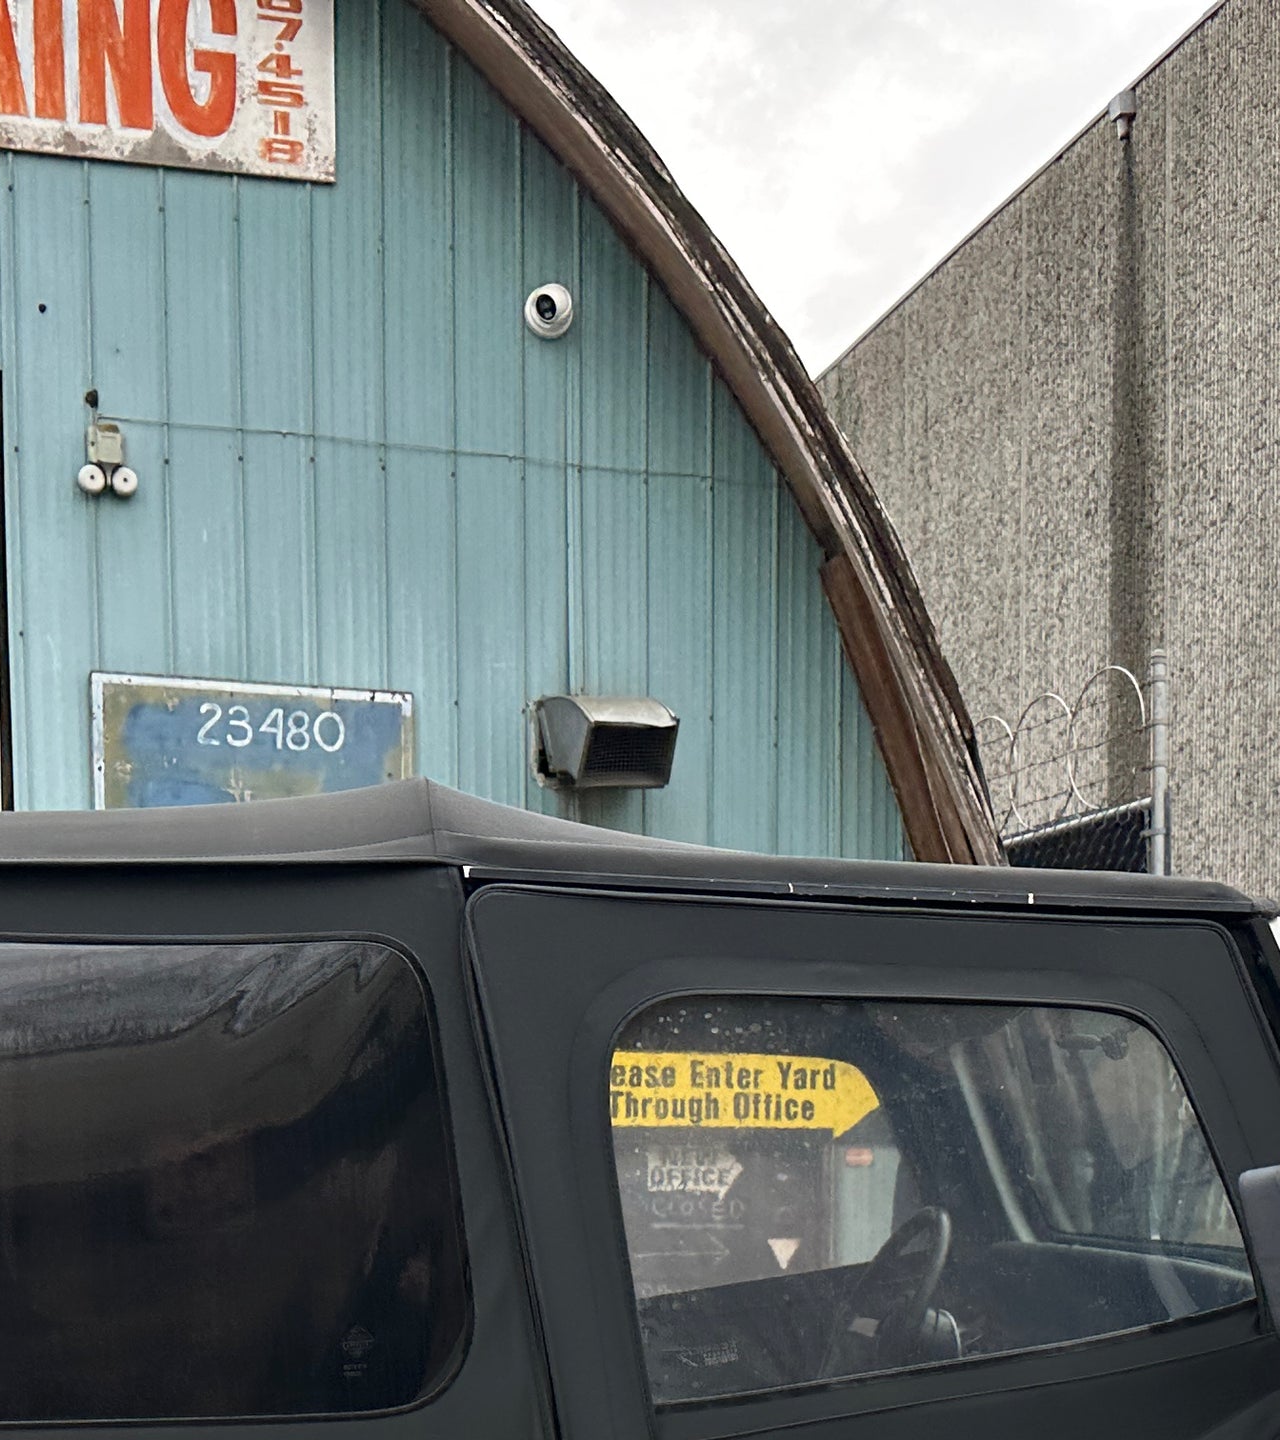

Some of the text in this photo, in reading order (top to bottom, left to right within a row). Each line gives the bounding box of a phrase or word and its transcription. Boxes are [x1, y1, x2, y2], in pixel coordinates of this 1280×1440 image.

[197, 702, 345, 752] 23480
[611, 1060, 836, 1091] ease Enter Yard
[610, 1091, 815, 1124] Through Office
